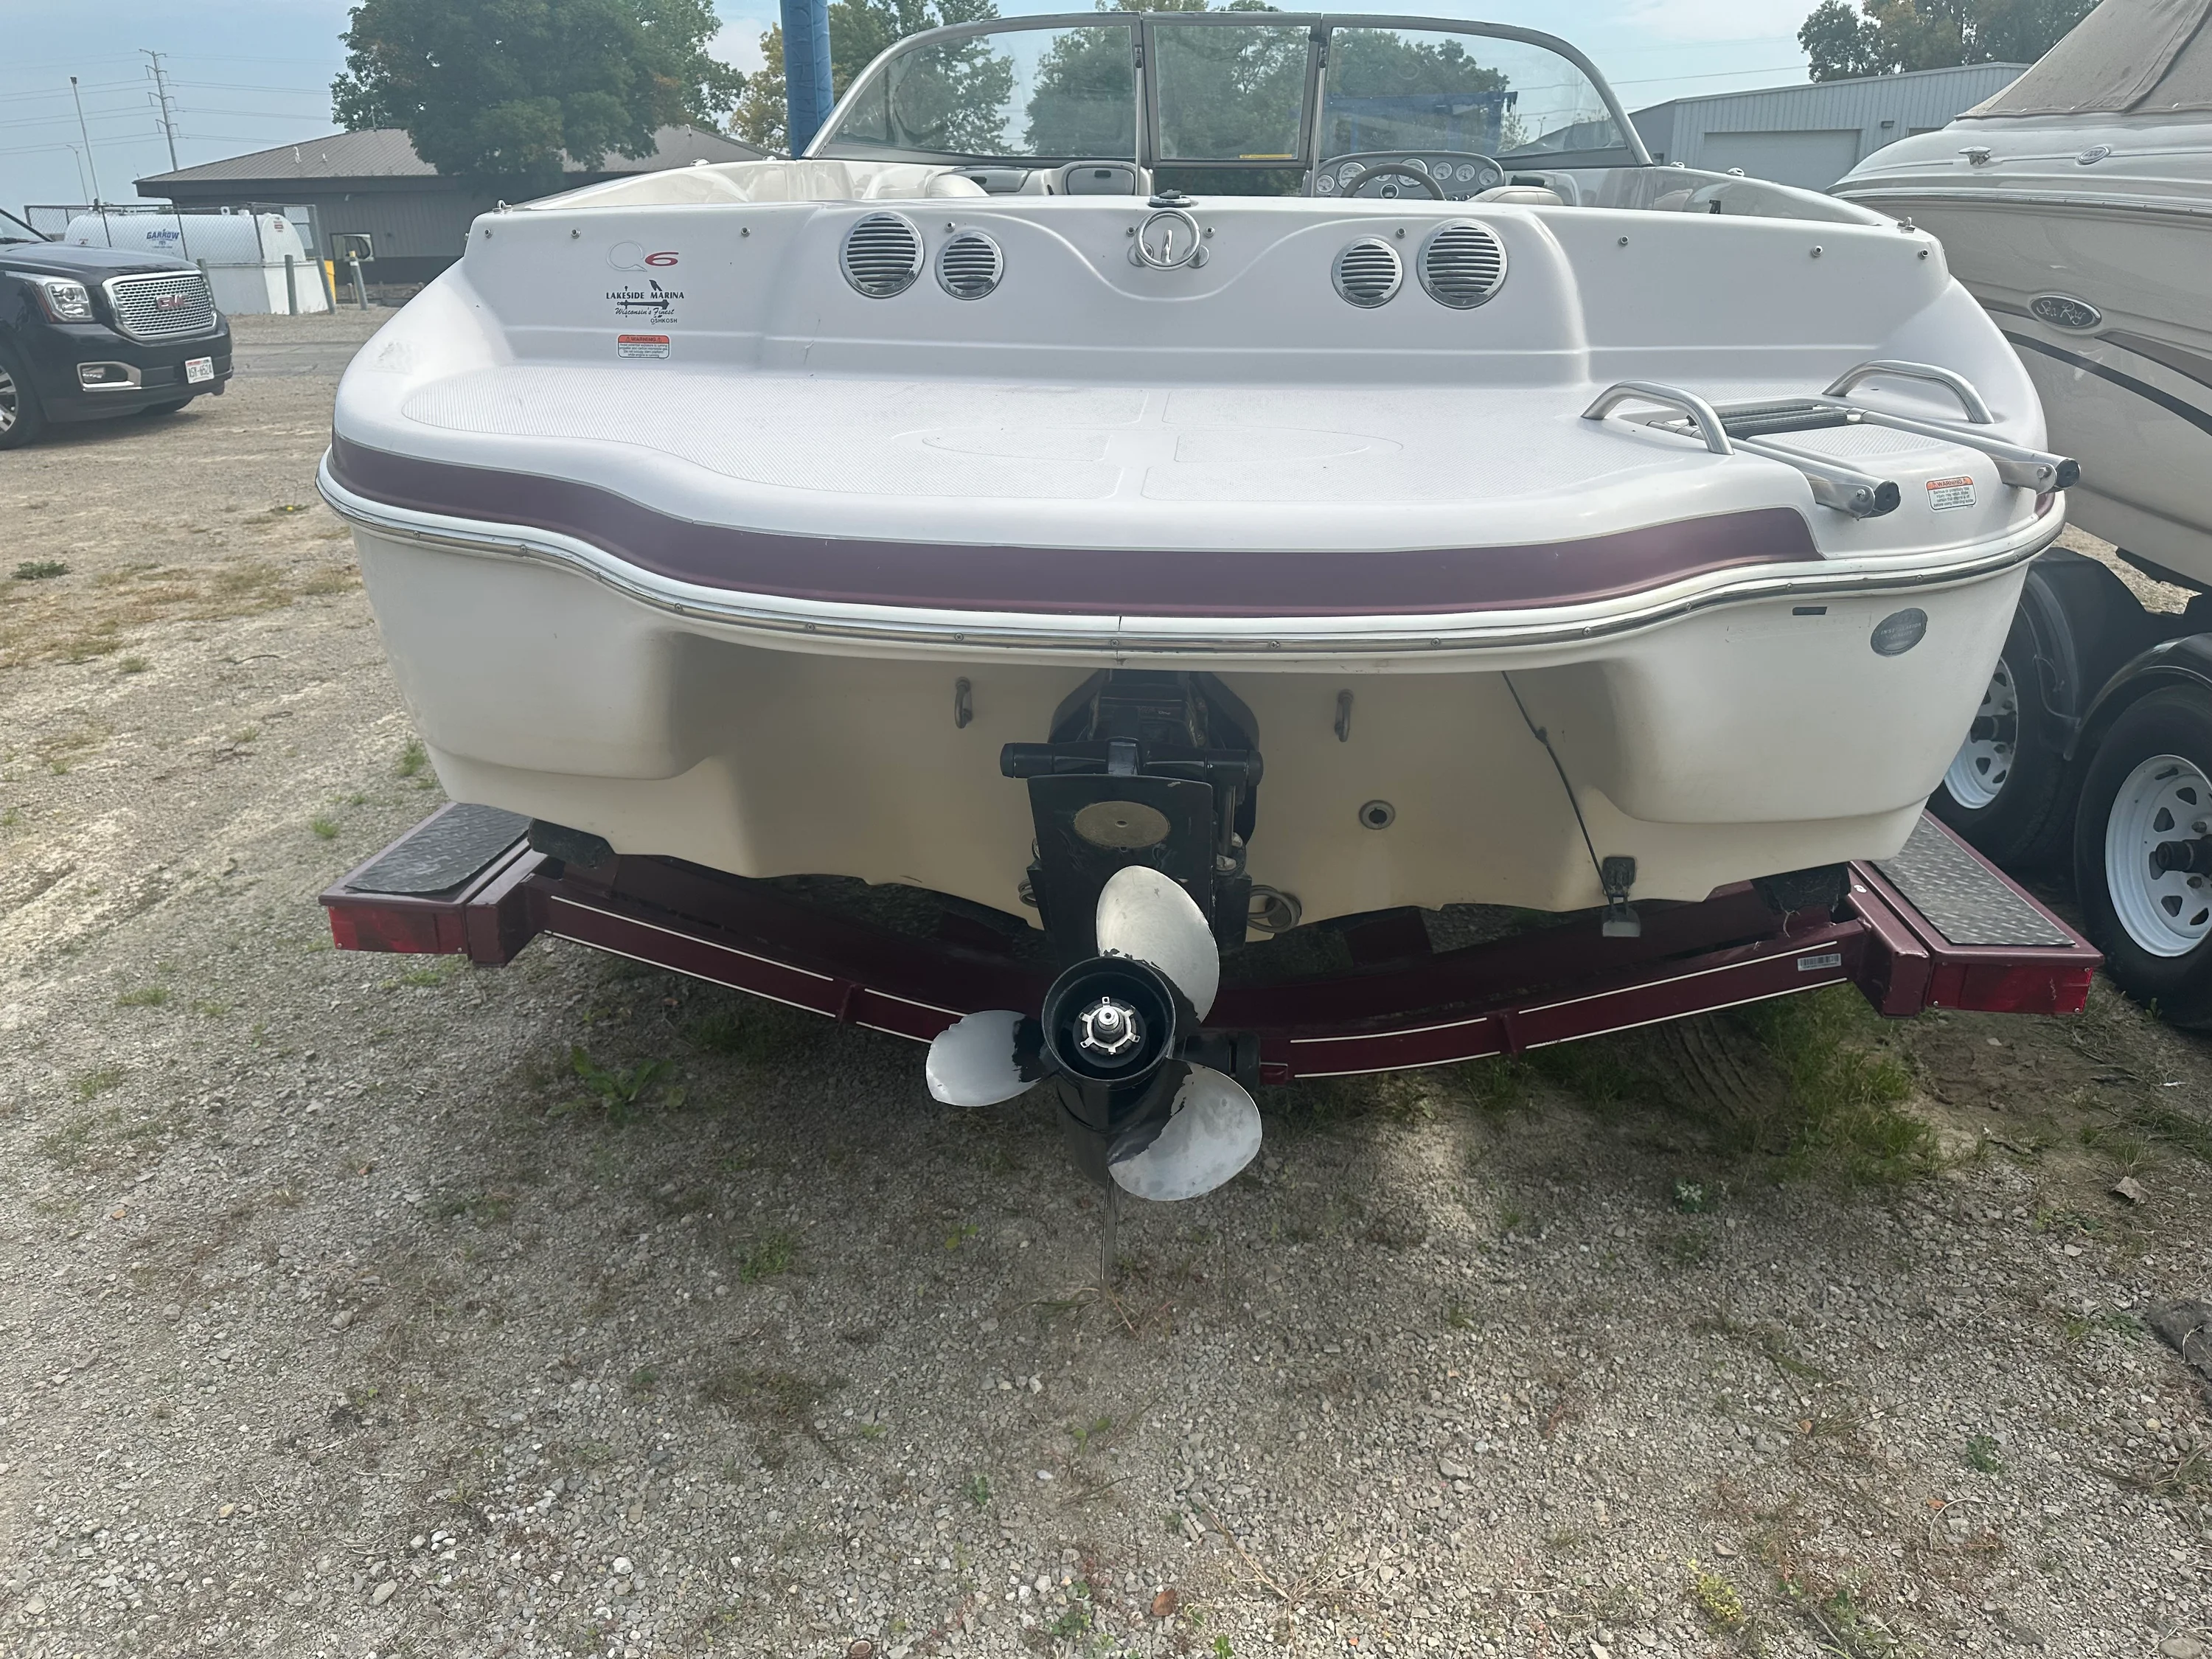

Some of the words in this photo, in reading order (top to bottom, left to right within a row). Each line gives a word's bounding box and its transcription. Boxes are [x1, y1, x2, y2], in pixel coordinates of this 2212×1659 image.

[147, 231, 179, 240] GARROW
[156, 294, 191, 310] GMC
[615, 307, 652, 316] Wisconsin's
[653, 307, 675, 316] Finest
[2037, 300, 2056, 316] Sea
[2060, 302, 2087, 325] Ray
